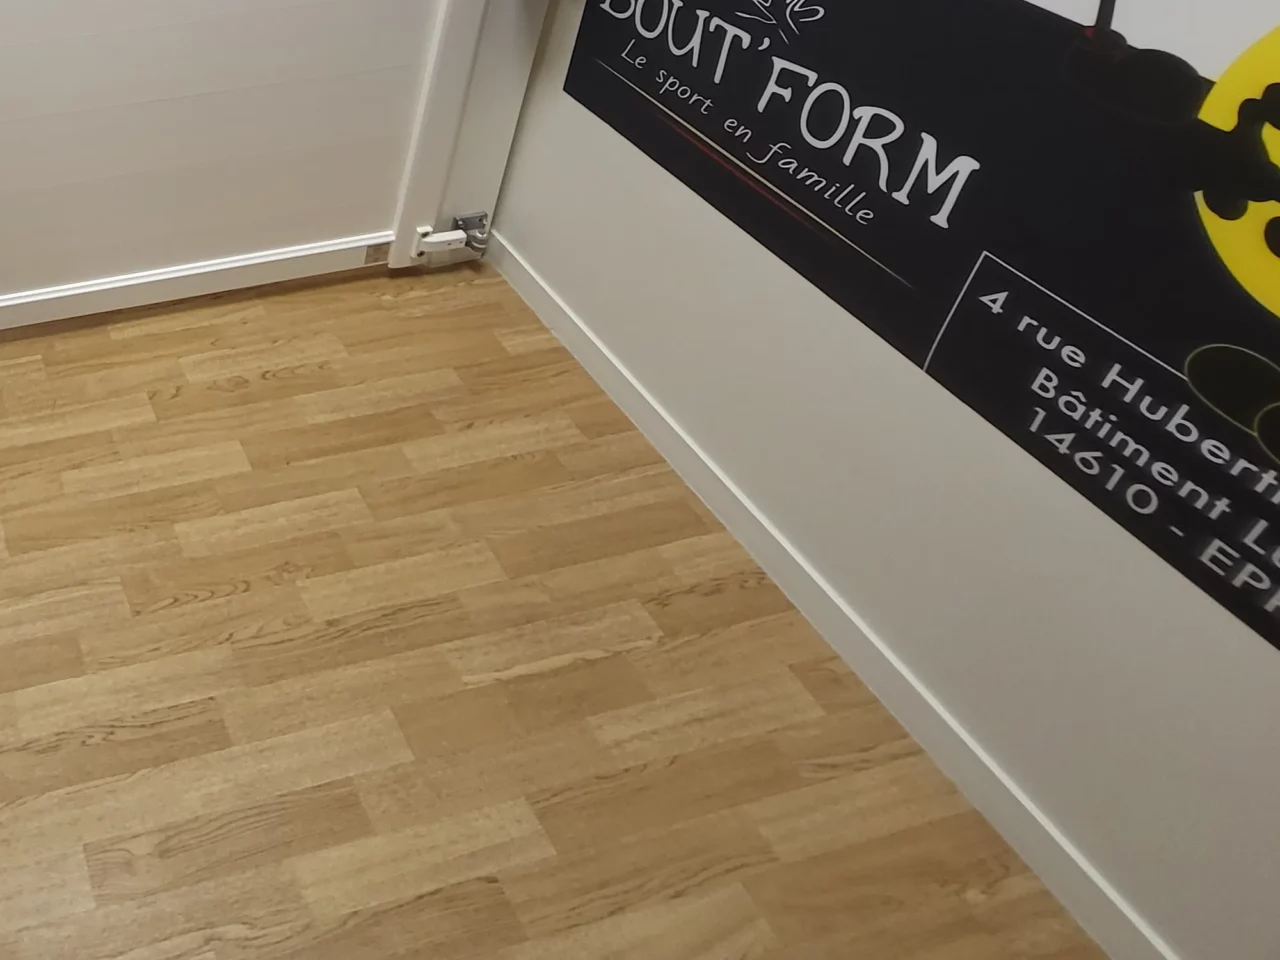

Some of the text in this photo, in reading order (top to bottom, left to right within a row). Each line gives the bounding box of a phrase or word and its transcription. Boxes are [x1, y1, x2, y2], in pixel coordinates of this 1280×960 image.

[621, 40, 874, 226] Le sport en famille
[978, 291, 1009, 314] 4
[1017, 315, 1086, 368] rue
[1028, 406, 1159, 515] 14610
[1031, 367, 1232, 520] Bâtiment
